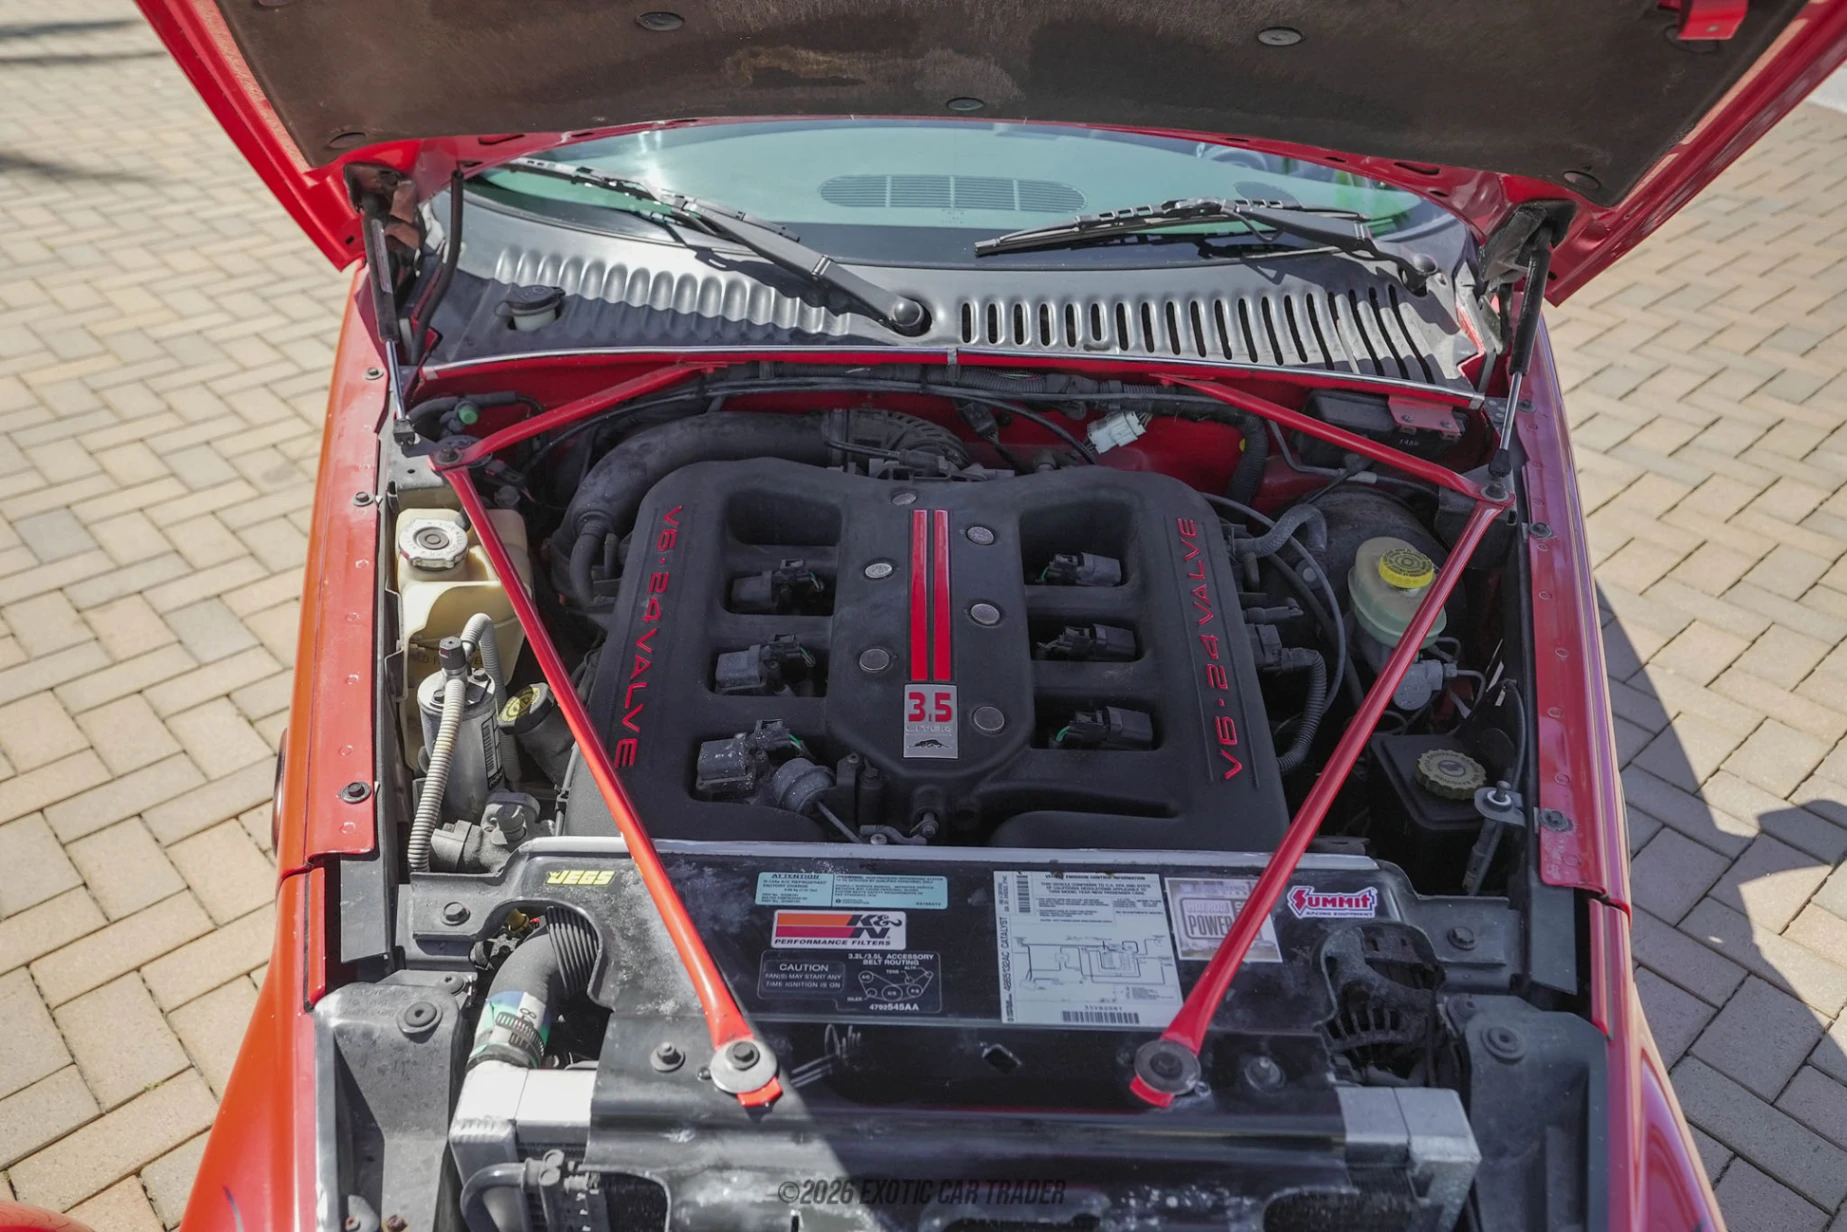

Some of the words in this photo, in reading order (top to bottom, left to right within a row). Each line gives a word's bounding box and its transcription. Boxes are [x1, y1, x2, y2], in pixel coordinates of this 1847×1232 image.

[908, 691, 953, 723] 3.5
[546, 870, 616, 885] JEGS
[847, 914, 902, 939] K&N
[999, 917, 1010, 949] CATALYST
[1188, 915, 1233, 936] POWER
[774, 938, 848, 946] PERFORMANCE
[780, 963, 829, 972] CAUTION
